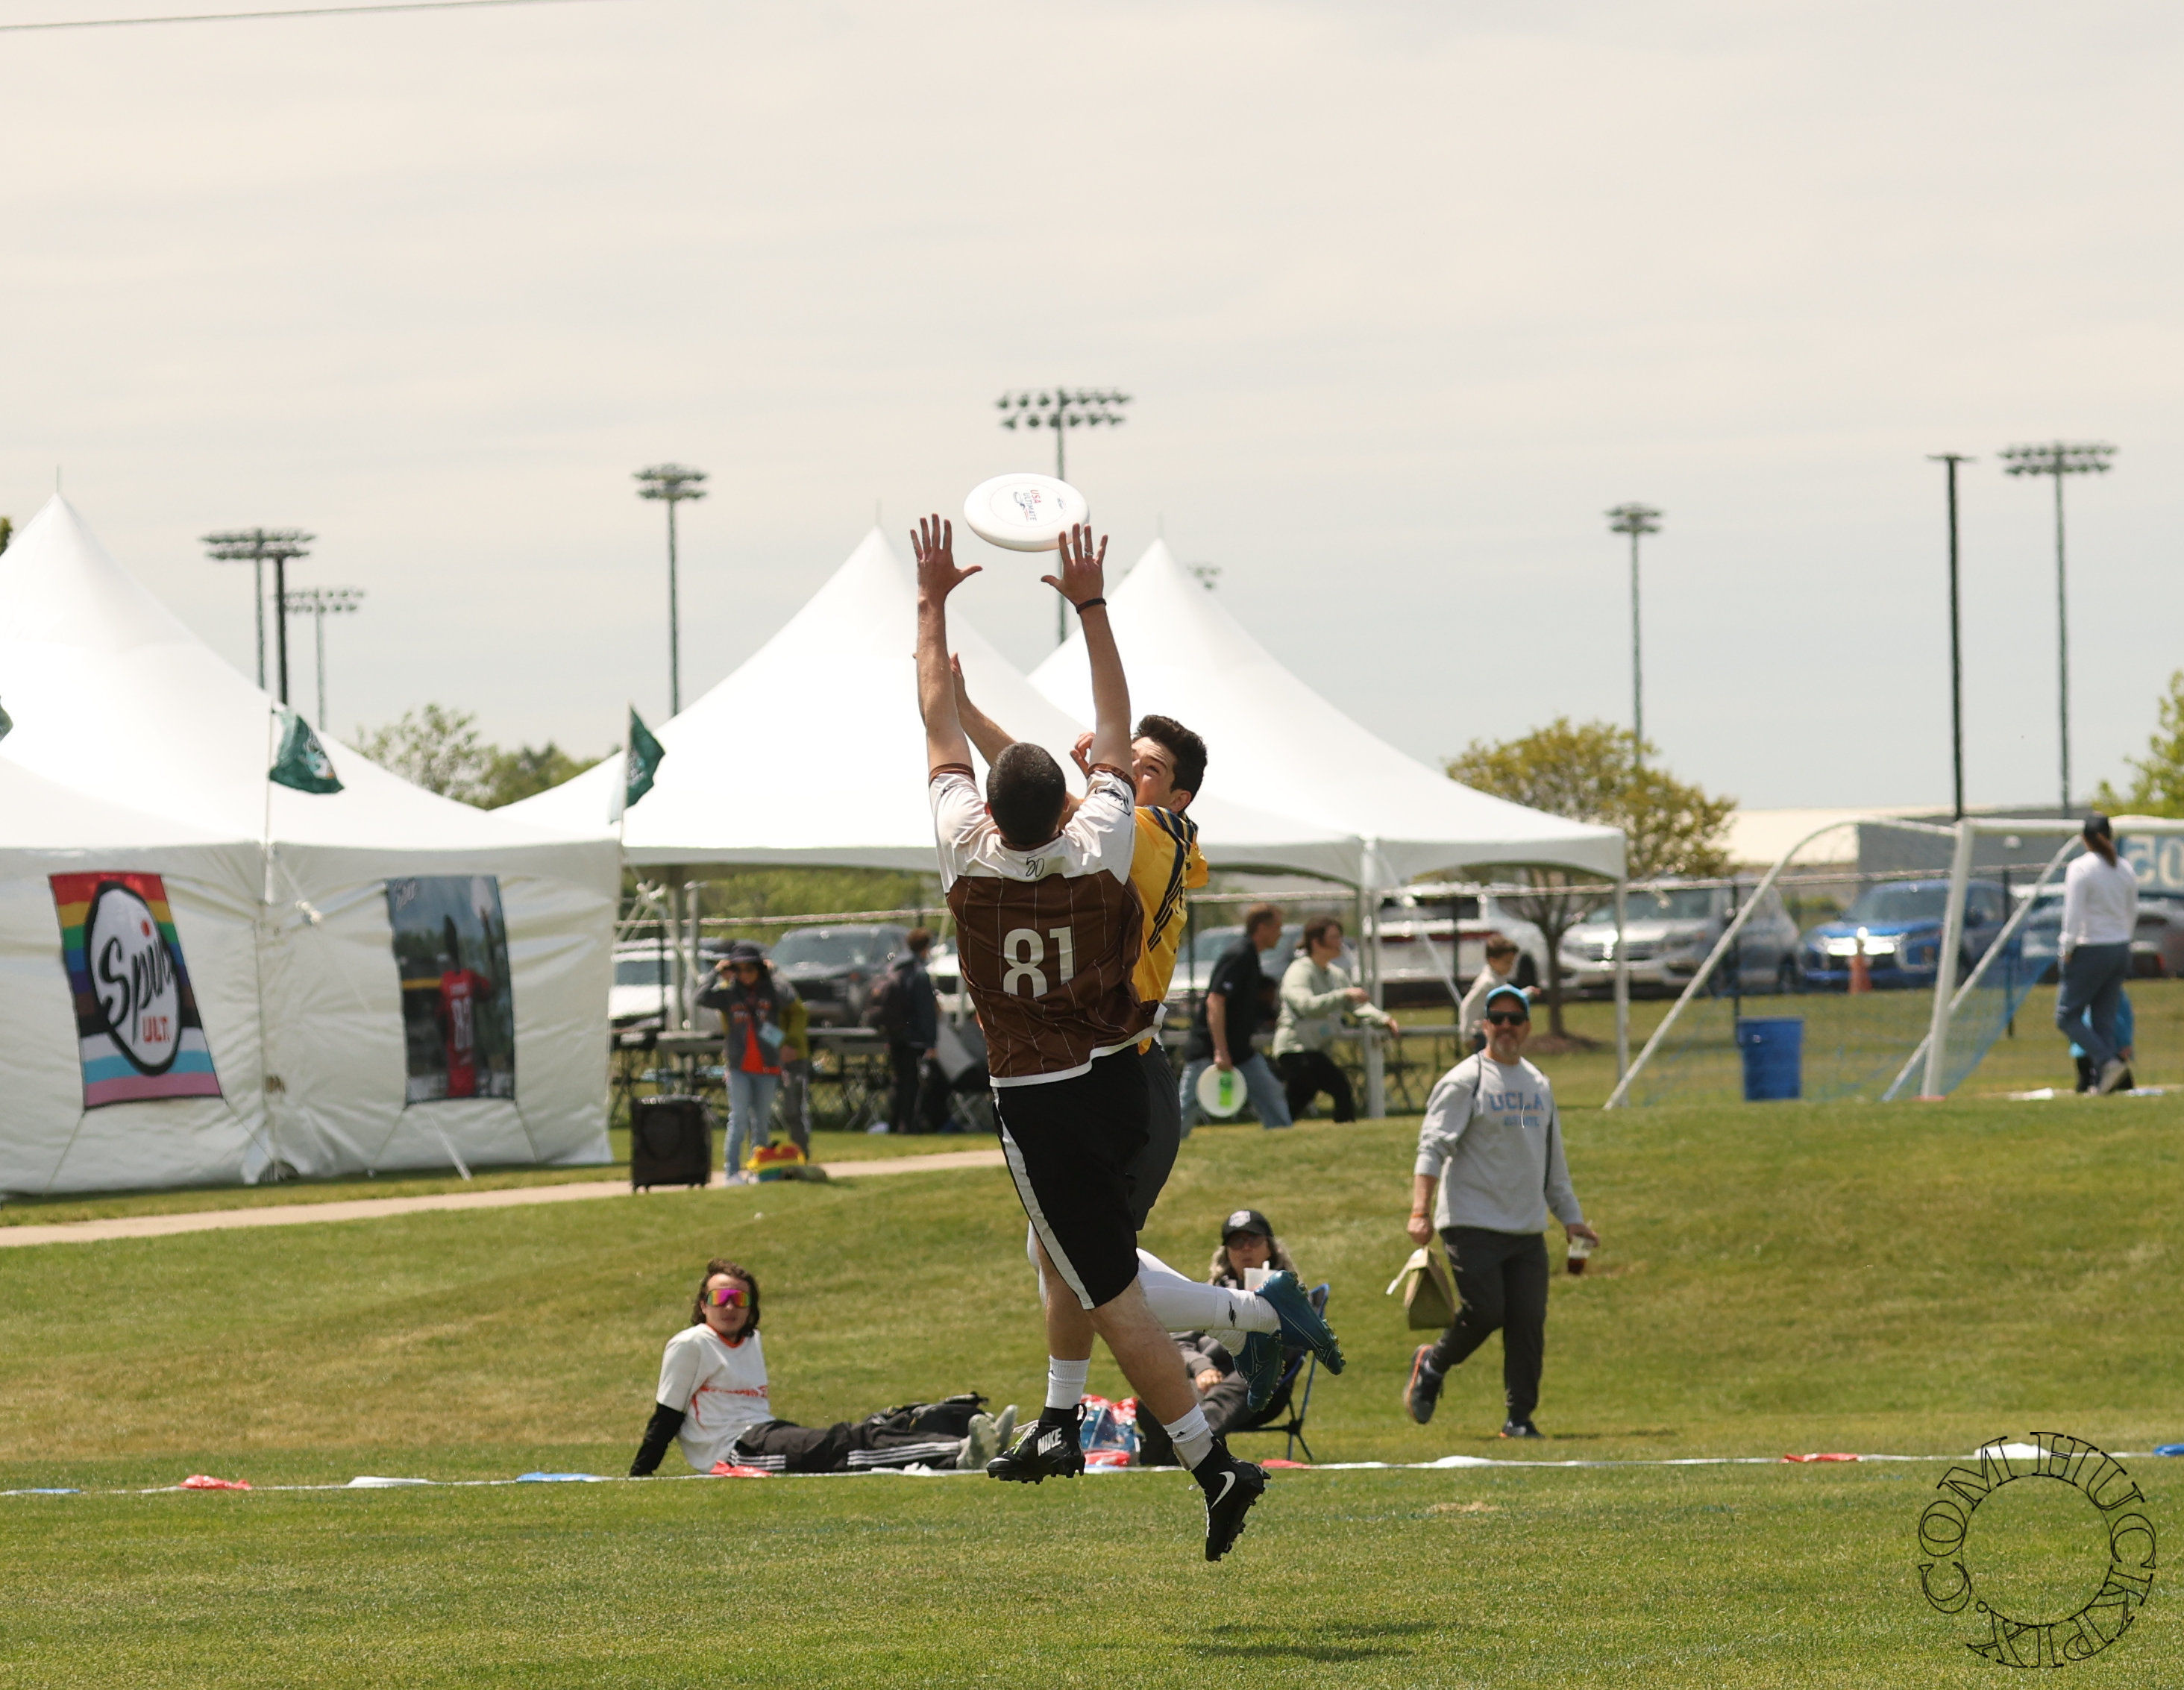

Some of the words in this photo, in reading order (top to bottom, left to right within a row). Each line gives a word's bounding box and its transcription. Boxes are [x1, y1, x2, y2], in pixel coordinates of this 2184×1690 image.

[1030, 489, 1041, 503] USA
[1026, 855, 1044, 878] 50
[1003, 926, 1074, 999] 81
[1489, 1092, 1544, 1111] UCLA
[1038, 1427, 1061, 1457] NIKE
